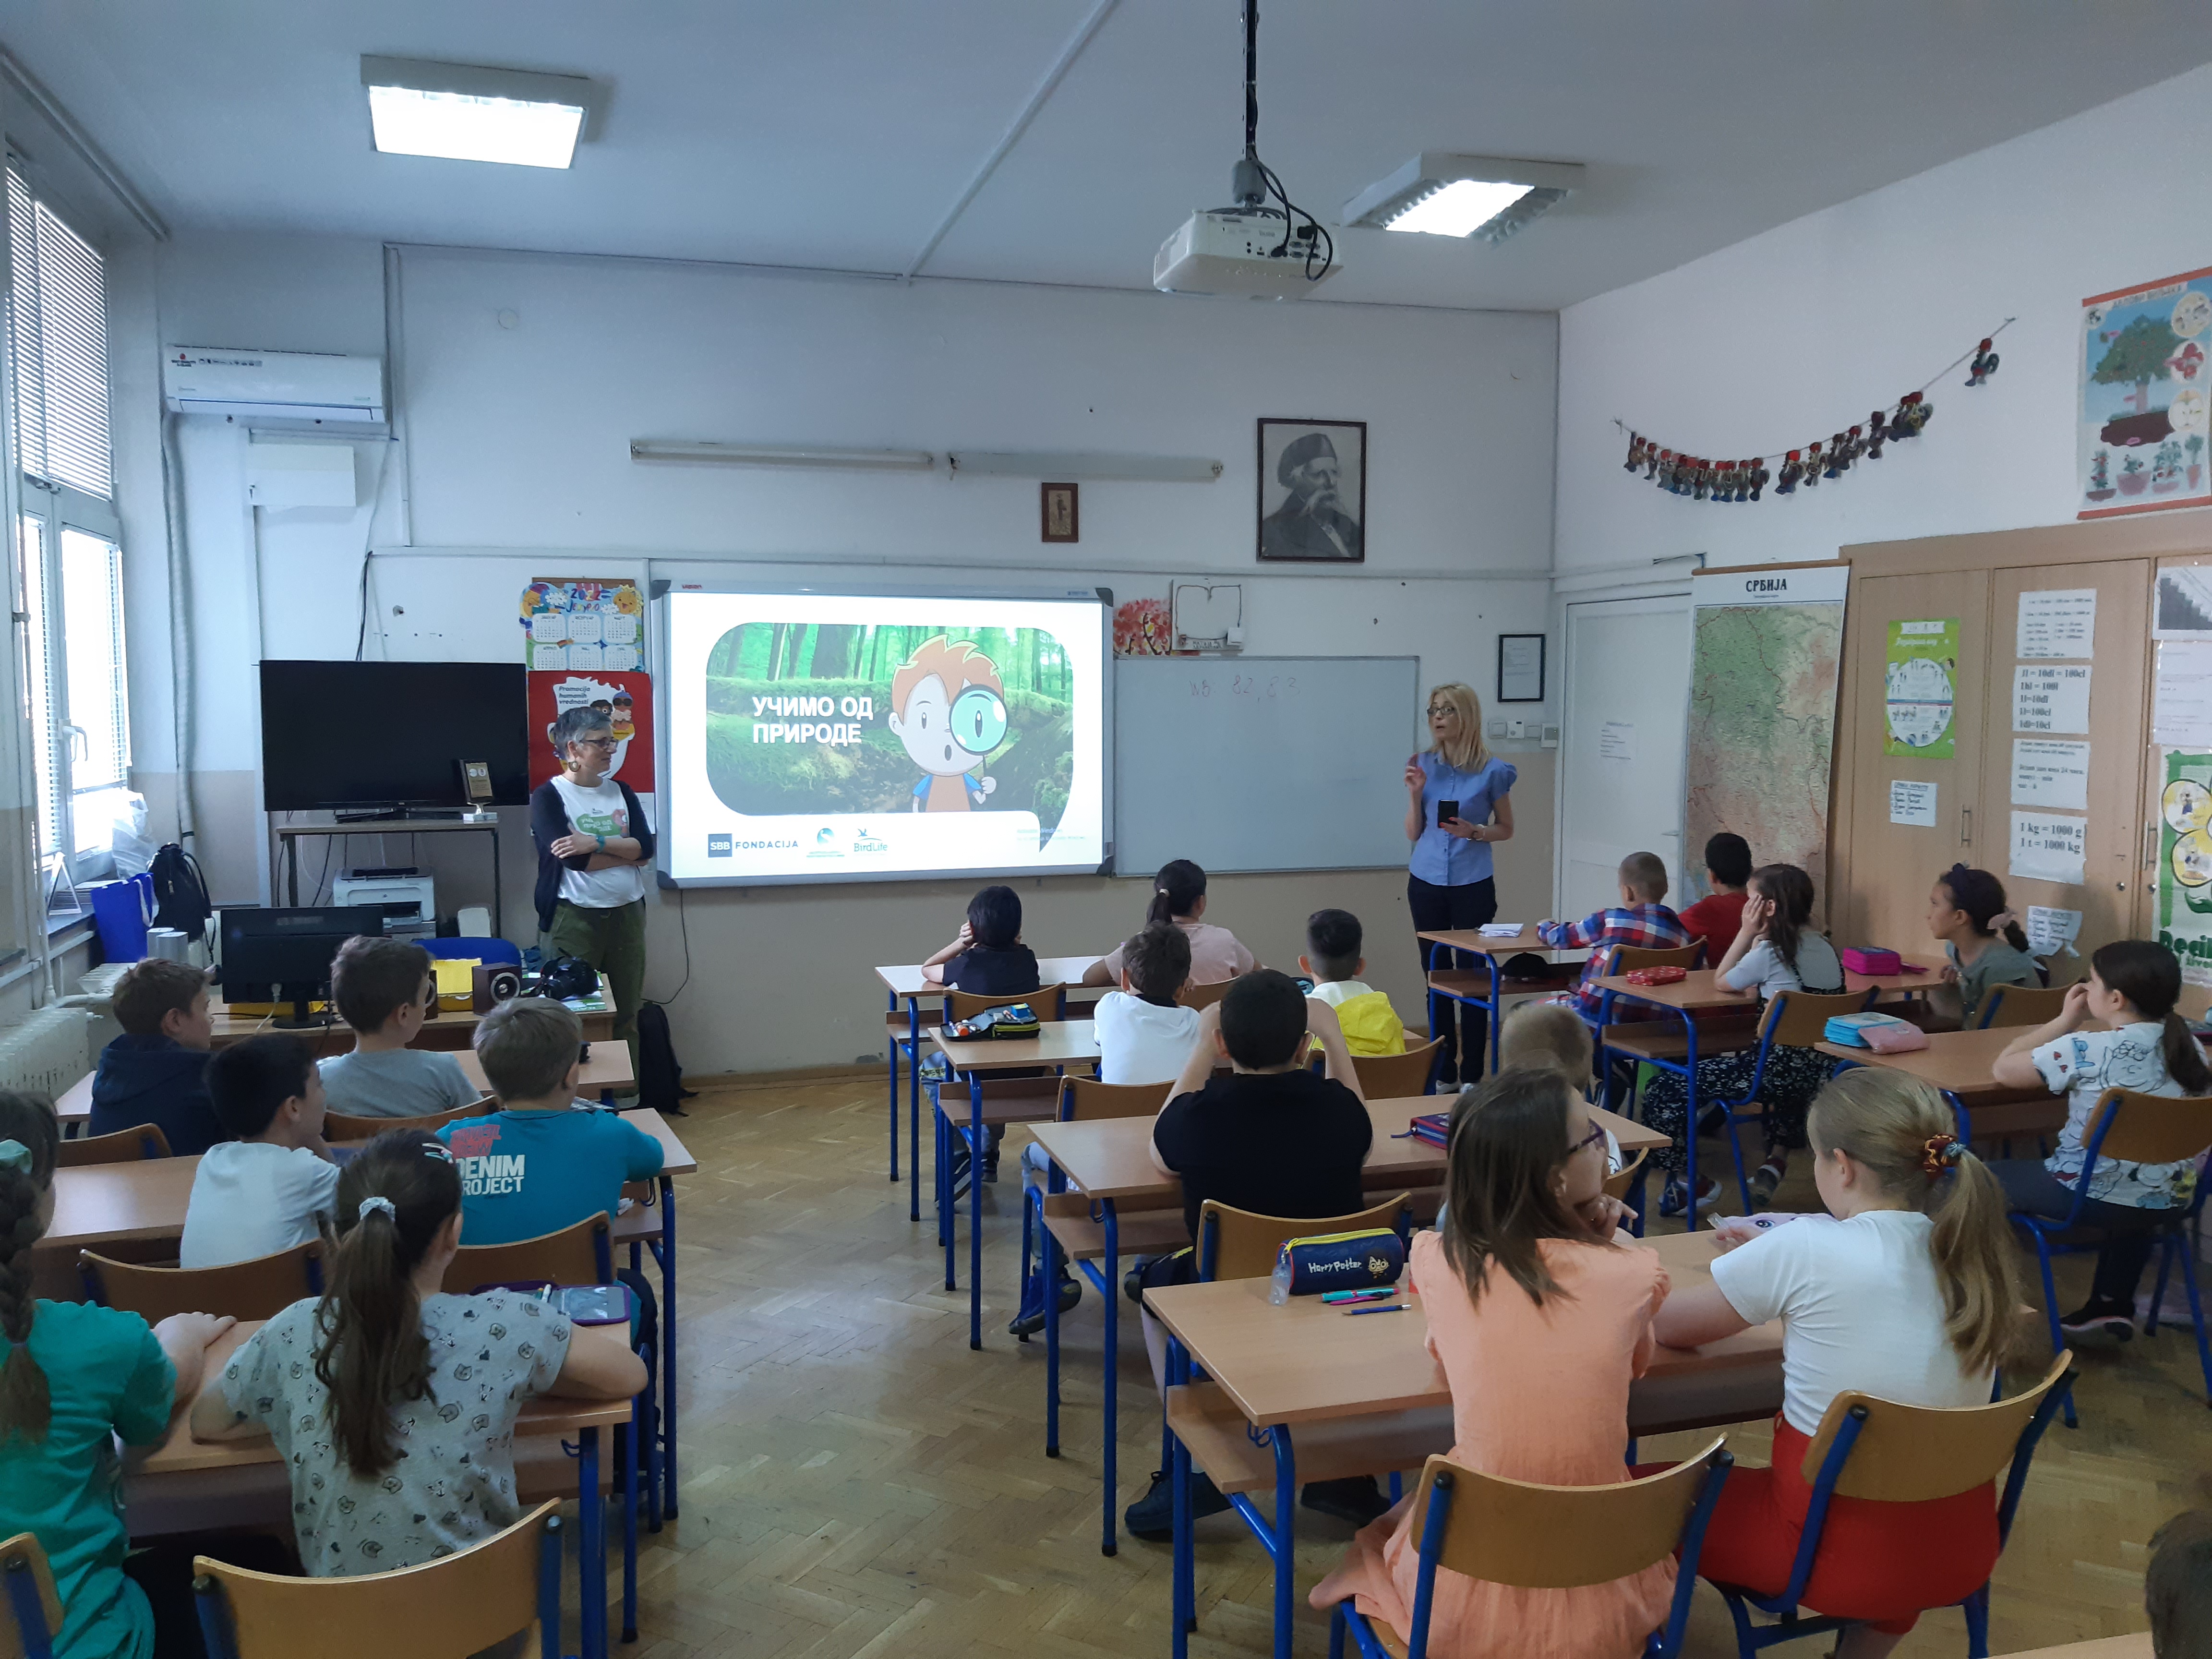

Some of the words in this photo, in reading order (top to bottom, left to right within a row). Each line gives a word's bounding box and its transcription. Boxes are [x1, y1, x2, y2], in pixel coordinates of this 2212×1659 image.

[1746, 578, 1787, 592] СРБИЈА
[752, 697, 834, 717] УЧИМО
[841, 697, 873, 720] ОД
[753, 723, 862, 746] ПРИРОДЕ
[2027, 823, 2039, 835] kg
[2051, 825, 2073, 836] 1000
[2075, 829, 2082, 839] g
[710, 842, 730, 850] SBB
[735, 841, 798, 849] FONDACIJA
[854, 843, 888, 852] BirdLife
[2044, 840, 2065, 850] 1000
[2068, 842, 2080, 855] kg
[463, 1177, 524, 1195] ROJECT
[1308, 1262, 1333, 1273] Harry
[1334, 1258, 1362, 1272] Potter
